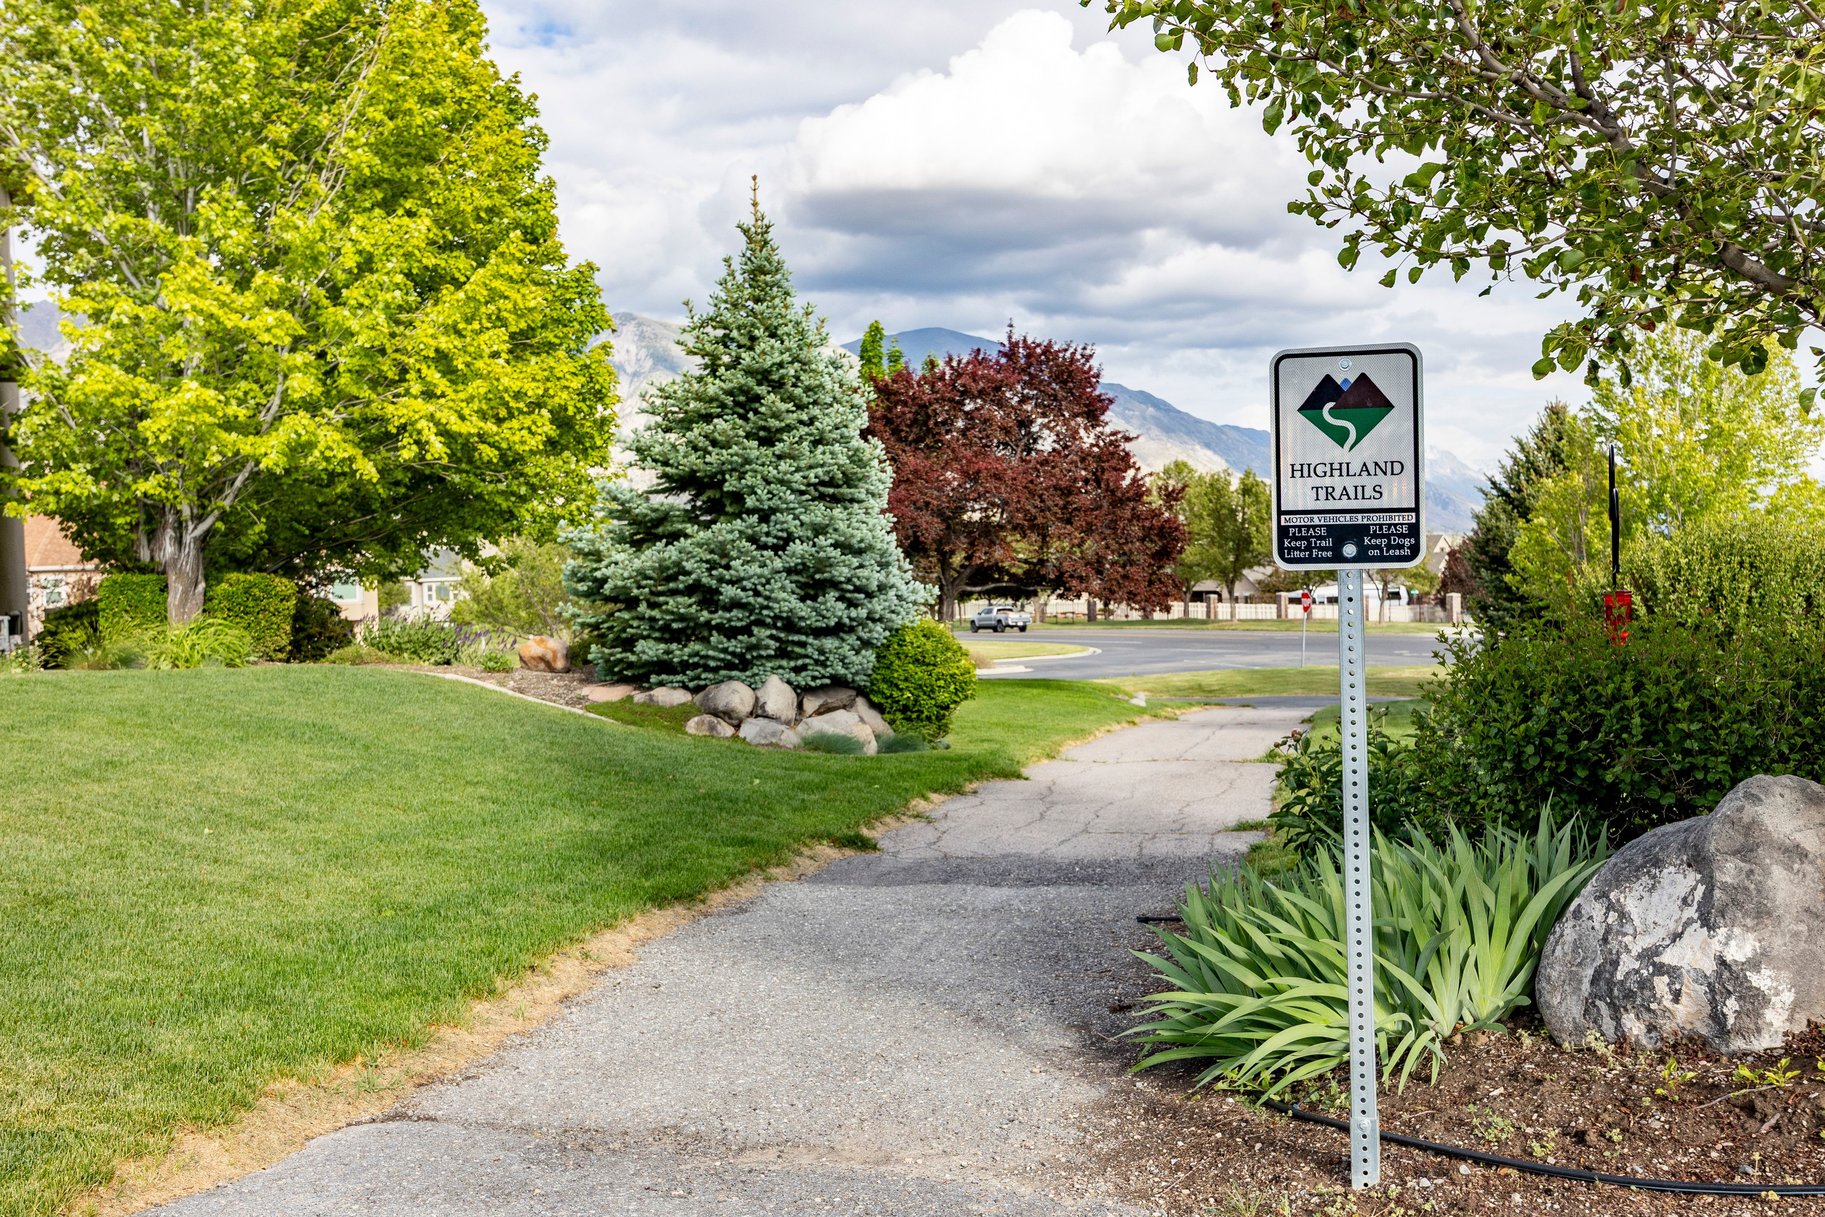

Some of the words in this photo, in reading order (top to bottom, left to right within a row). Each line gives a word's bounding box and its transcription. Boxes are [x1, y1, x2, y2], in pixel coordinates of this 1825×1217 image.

[1289, 460, 1405, 479] HIGHLAND
[1311, 484, 1383, 501] TRAILS
[1283, 516, 1315, 524] MOTOR
[1317, 515, 1359, 523] VEHICLES
[1361, 514, 1414, 522] PROHIBITED
[1288, 527, 1327, 536] PLEASE
[1369, 525, 1409, 534] PLEASE
[1283, 538, 1307, 549] Keep
[1310, 538, 1333, 547] Trail
[1363, 536, 1388, 546] Keep
[1390, 536, 1415, 547] Dogs
[1284, 549, 1309, 558] Litter
[1312, 548, 1333, 558] Free
[1383, 547, 1411, 556] Leash
